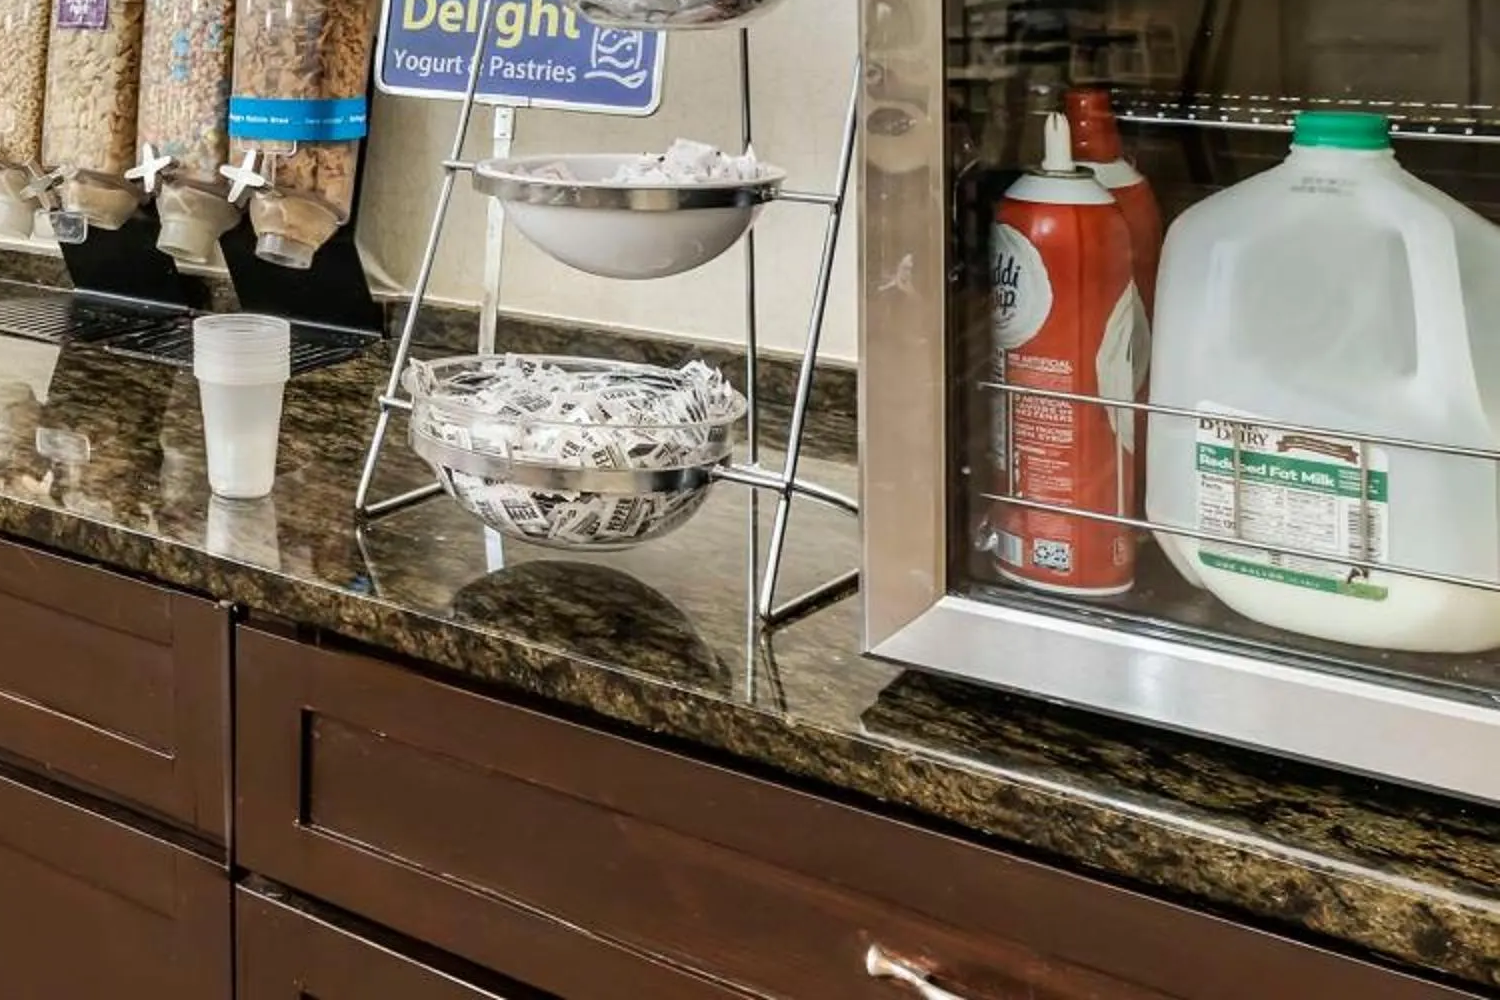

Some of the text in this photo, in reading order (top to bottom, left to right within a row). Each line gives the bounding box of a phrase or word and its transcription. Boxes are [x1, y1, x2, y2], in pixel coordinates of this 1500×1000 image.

[394, 48, 463, 77] Yogurt
[489, 55, 577, 83] Pastries
[1269, 463, 1299, 482] Fat
[1301, 470, 1336, 488] Milk
